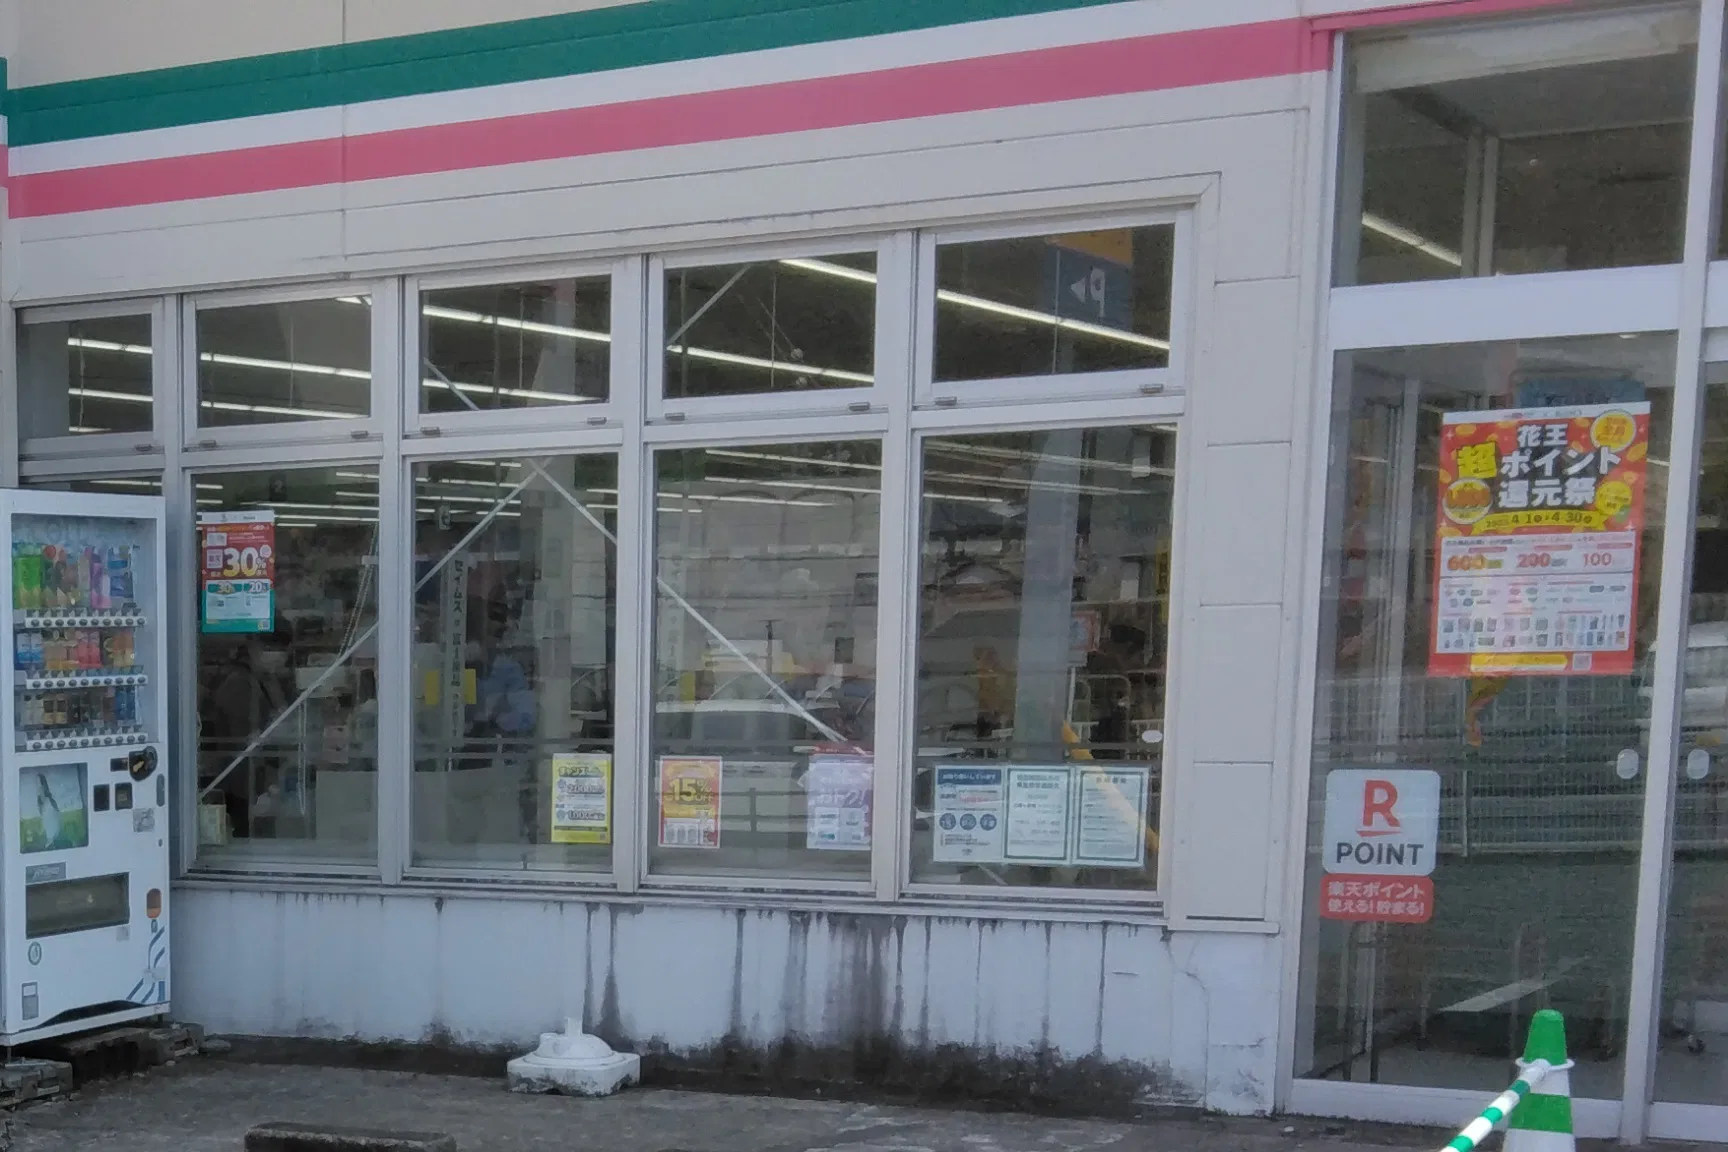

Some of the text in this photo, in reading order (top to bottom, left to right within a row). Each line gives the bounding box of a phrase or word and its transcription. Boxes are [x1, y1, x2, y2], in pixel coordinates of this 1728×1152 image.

[1517, 424, 1568, 447] 花王
[1500, 446, 1621, 478] ポイント
[1498, 477, 1596, 508] 還元祭
[1583, 552, 1612, 566] 100
[1363, 780, 1401, 827] R
[1336, 842, 1424, 866] POINT
